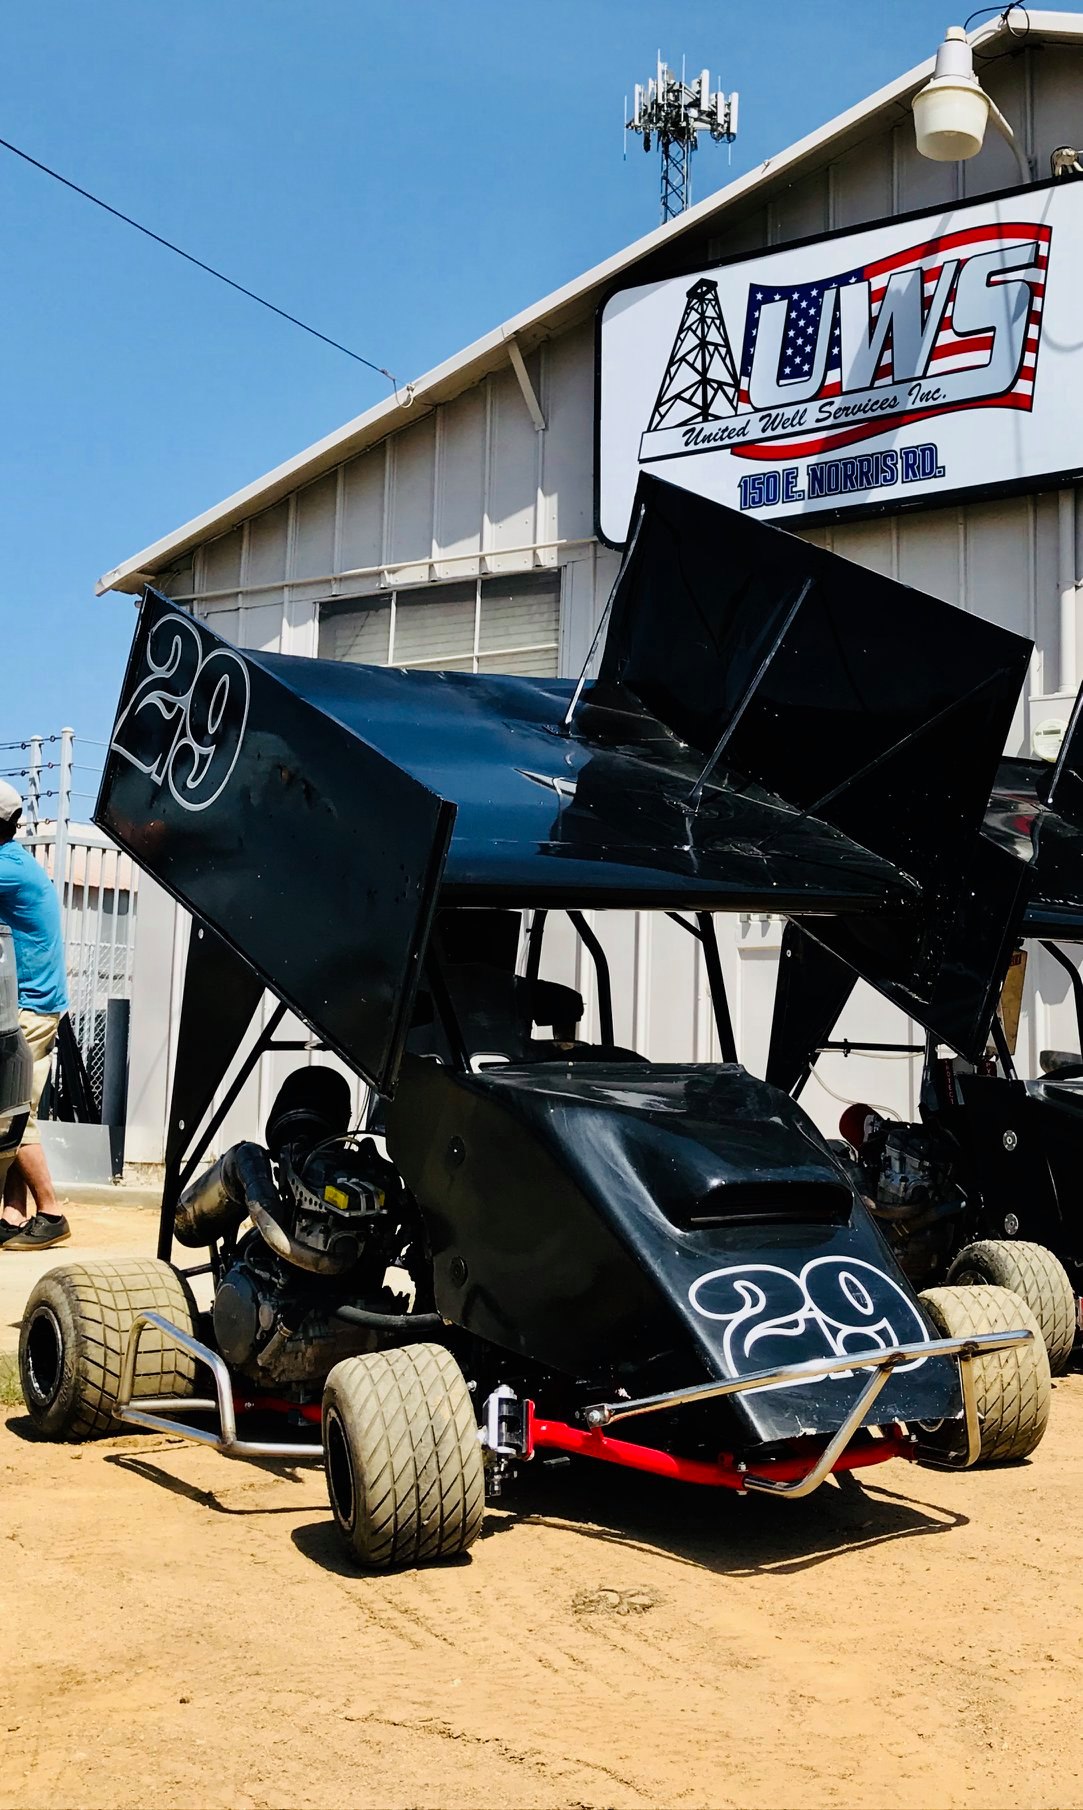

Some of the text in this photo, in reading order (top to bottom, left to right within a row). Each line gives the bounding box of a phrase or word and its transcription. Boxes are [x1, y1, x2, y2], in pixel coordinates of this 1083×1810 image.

[748, 241, 1040, 412] UWS
[682, 382, 947, 447] United Well Services Inc.
[738, 443, 946, 511] 150 E. NORRIS RD.
[110, 612, 251, 812] 29
[687, 1255, 932, 1396] 29
